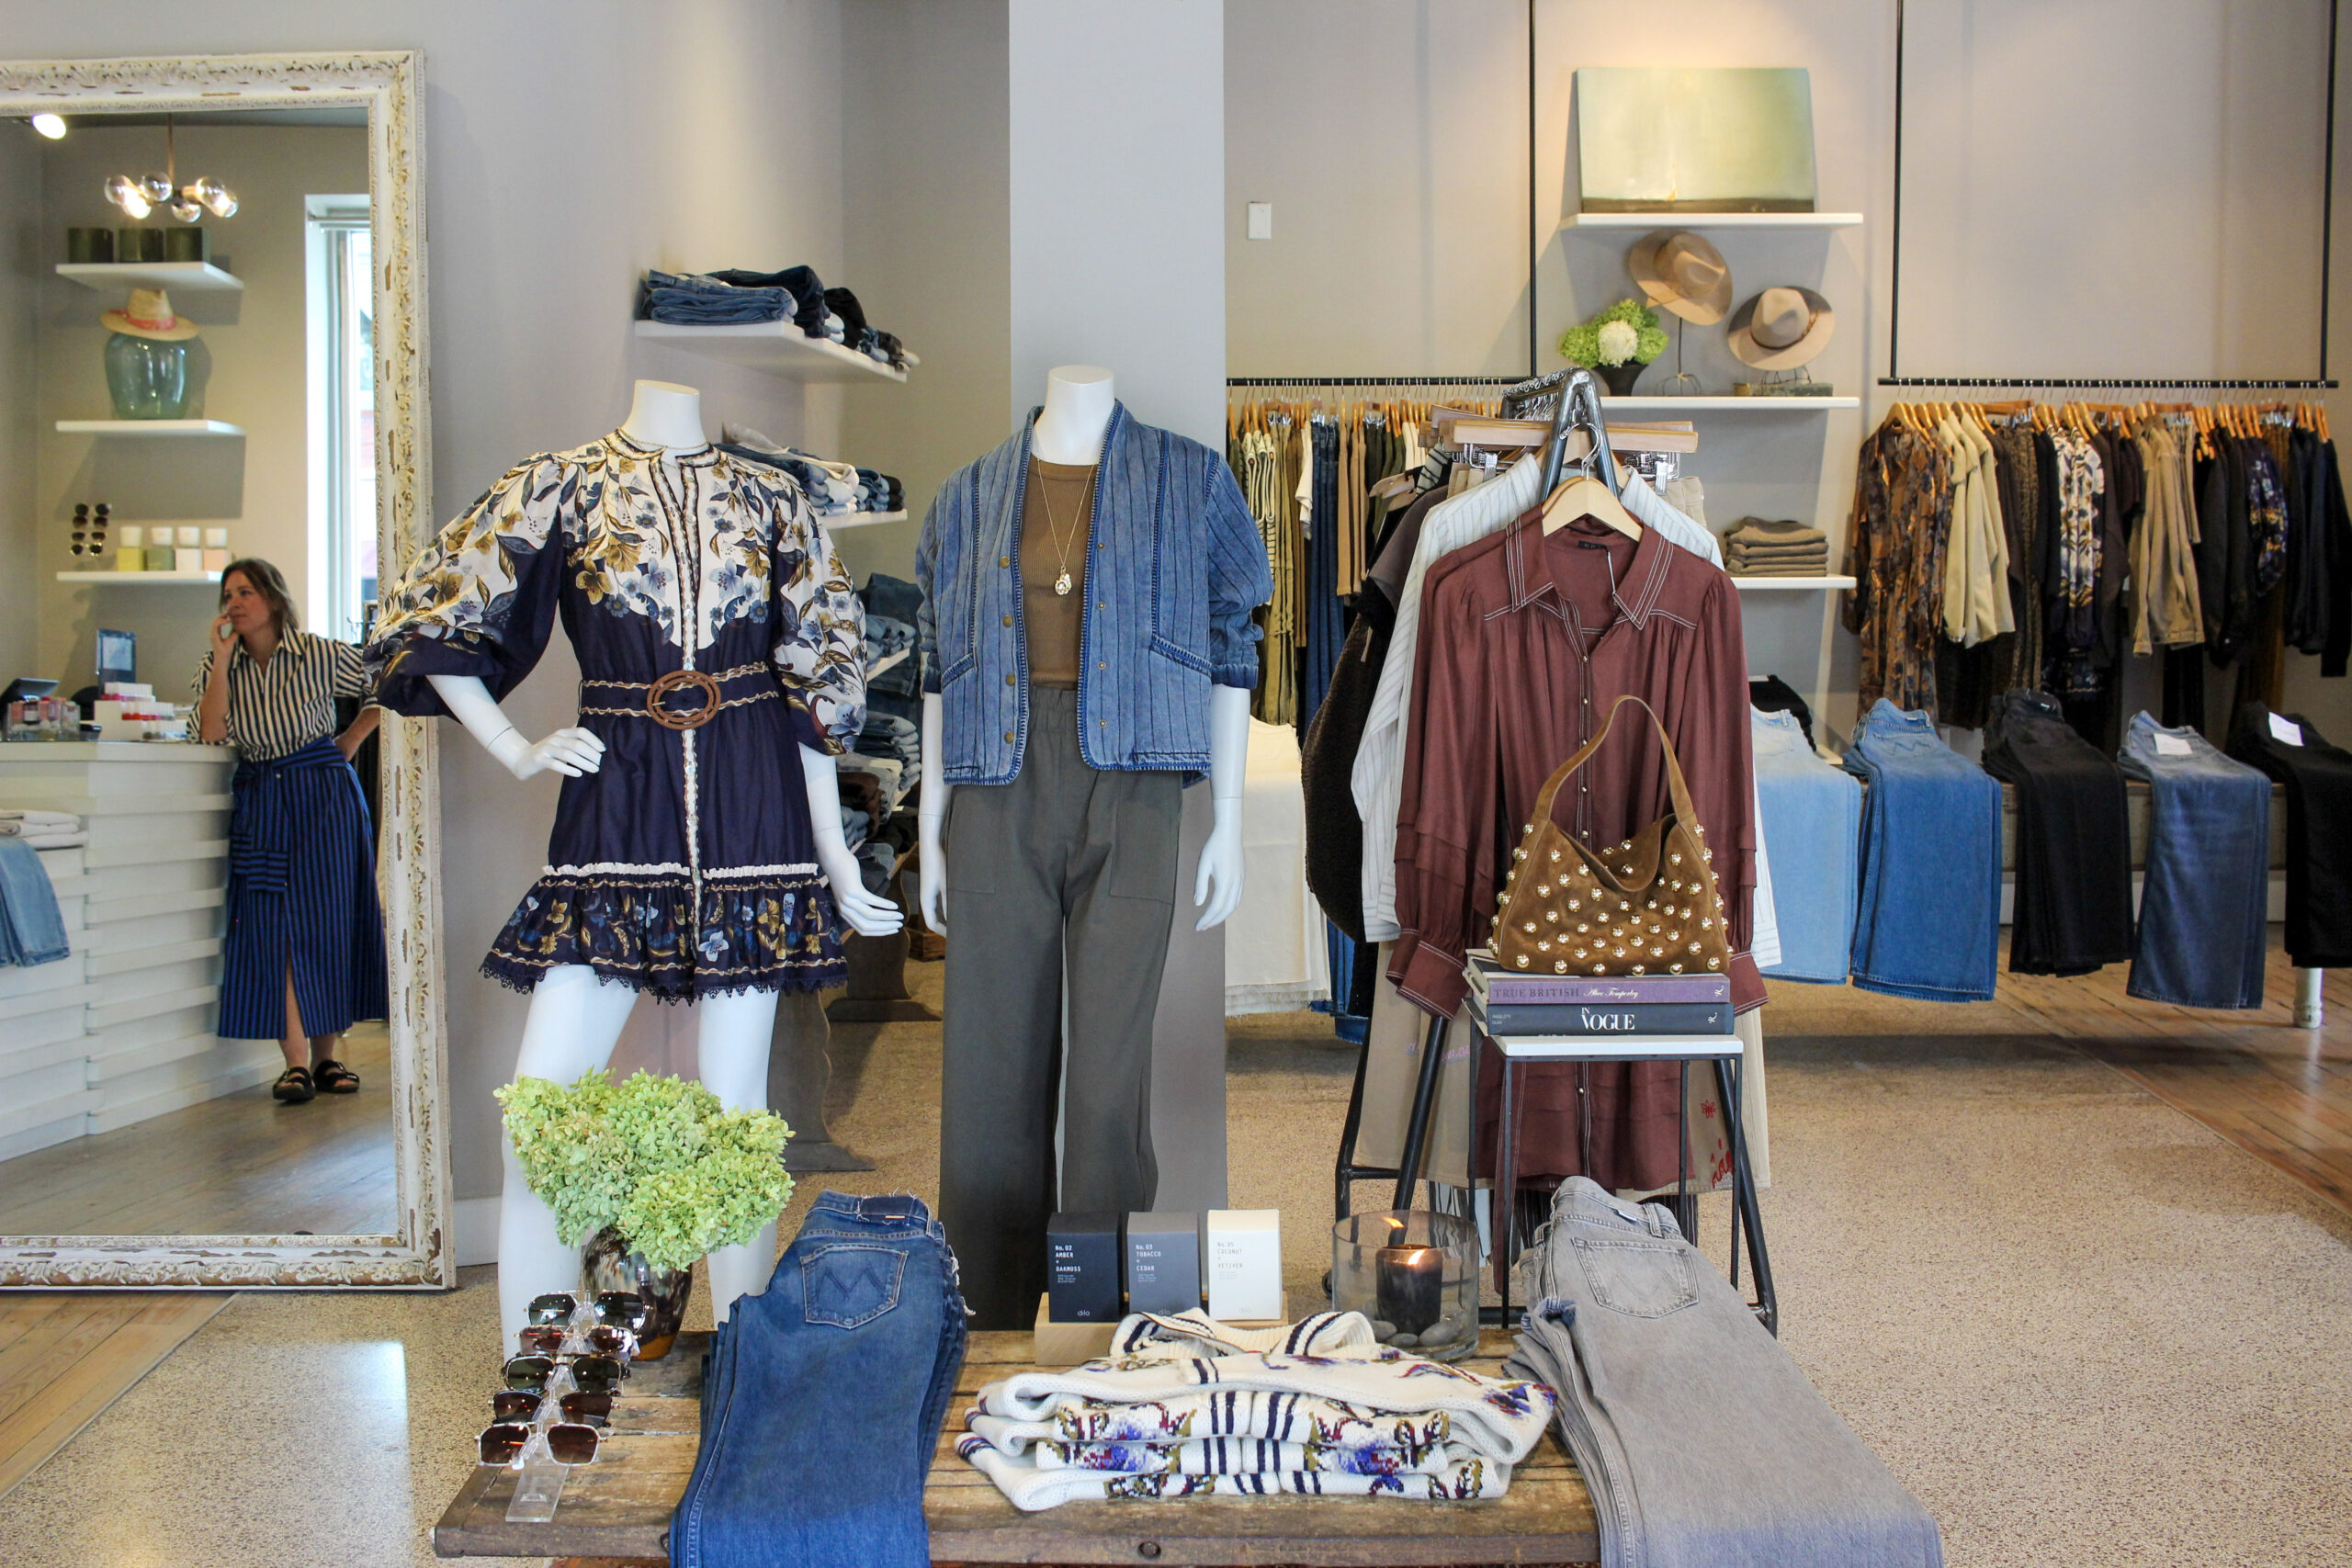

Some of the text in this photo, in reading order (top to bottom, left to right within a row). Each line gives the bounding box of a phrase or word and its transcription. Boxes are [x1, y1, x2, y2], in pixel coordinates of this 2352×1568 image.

[1494, 988, 1527, 998] TRUE
[1530, 987, 1579, 998] BRITISH
[1581, 1014, 1635, 1030] VOGUE
